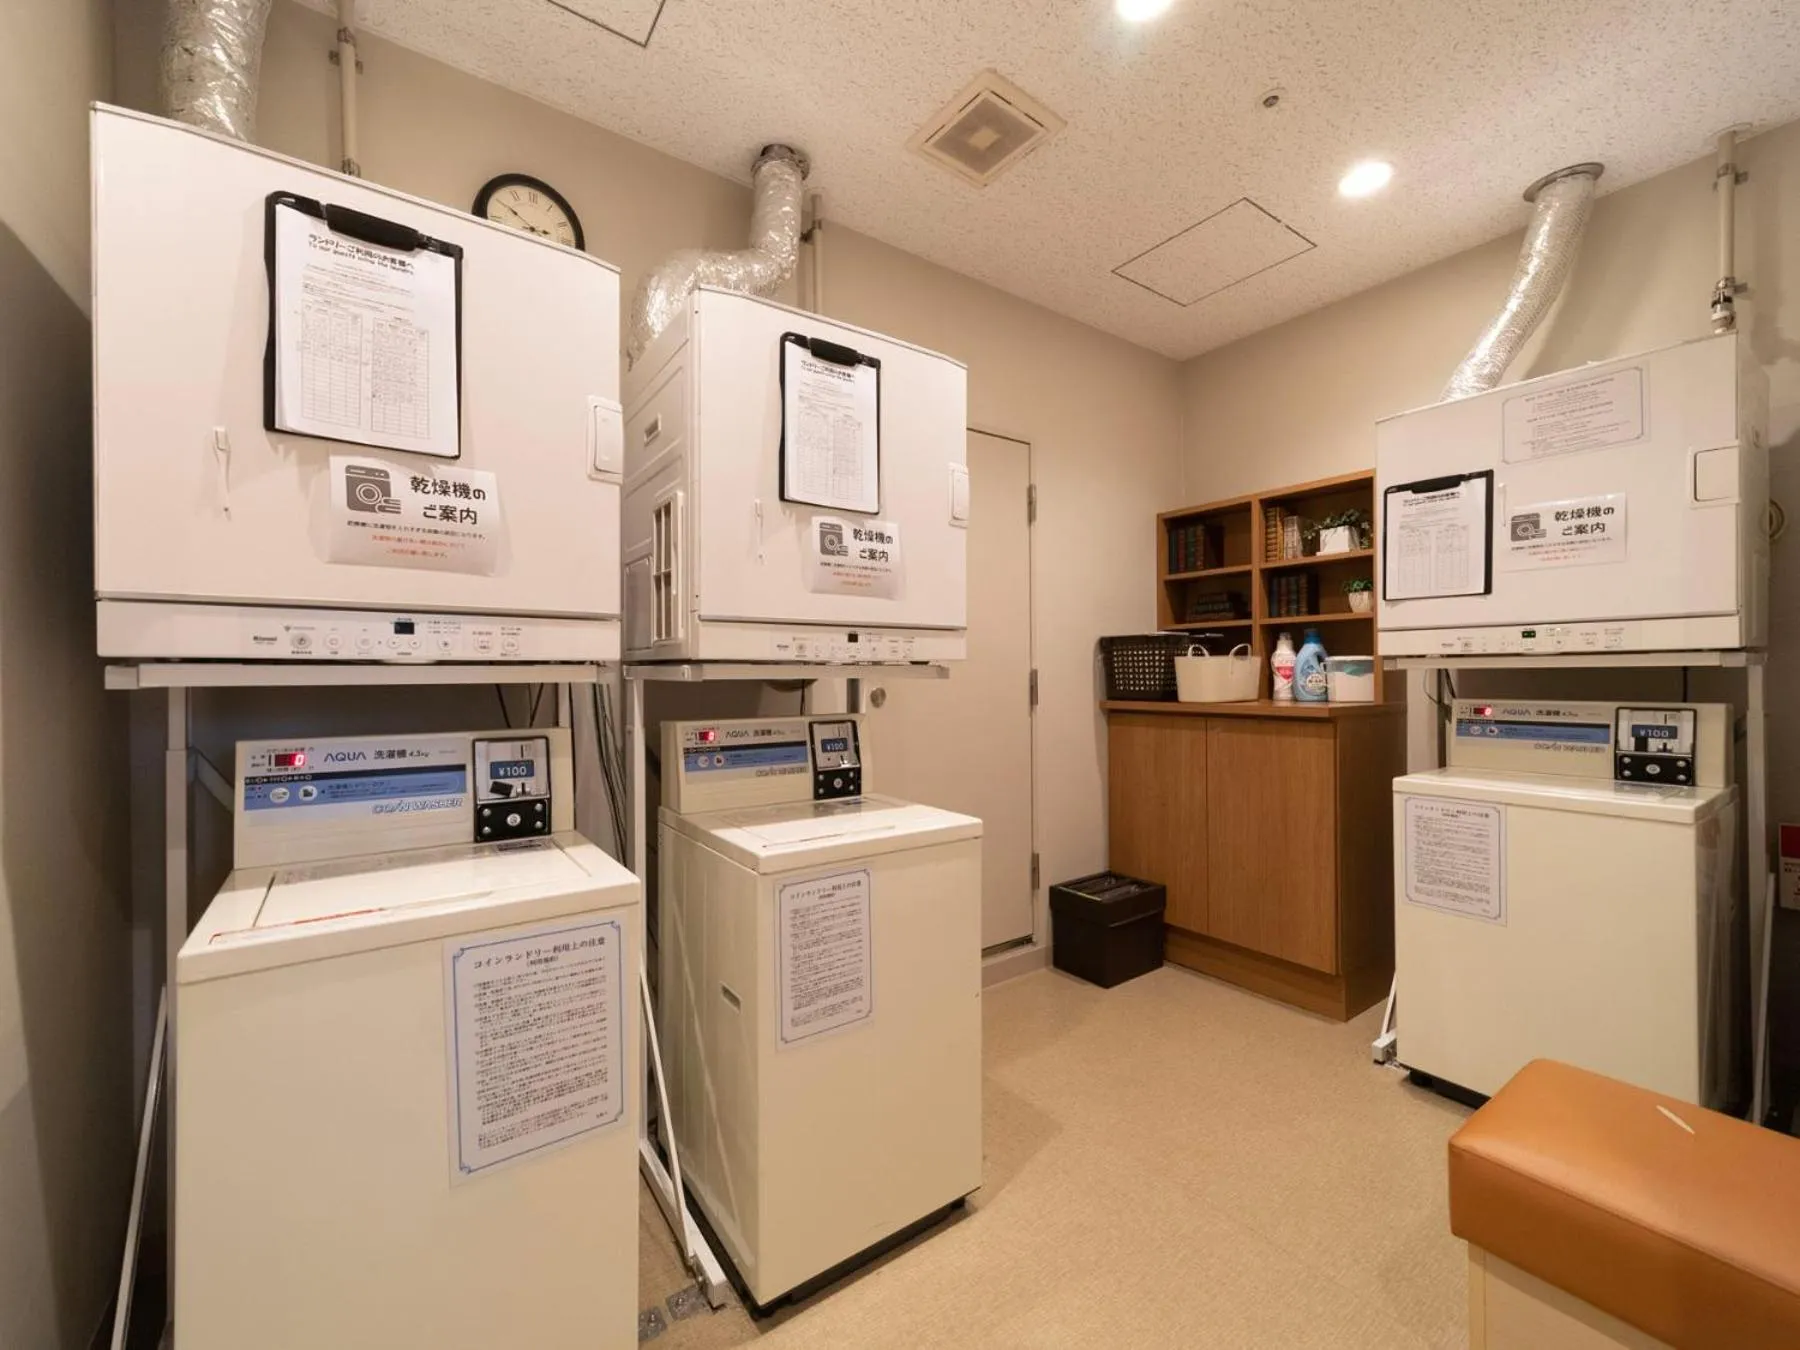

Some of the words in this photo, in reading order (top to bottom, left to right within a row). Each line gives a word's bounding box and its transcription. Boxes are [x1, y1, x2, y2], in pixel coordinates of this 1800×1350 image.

[410, 475, 486, 501] 乾燥機の
[423, 504, 478, 525] ご案内
[1554, 505, 1615, 521] 乾燥機の
[853, 527, 894, 545] 乾燥機の
[1562, 522, 1606, 536] ご案内
[859, 548, 889, 562] ご案内
[1502, 708, 1532, 717] AQUA
[1640, 728, 1669, 738] ¥100
[323, 751, 368, 763] AQUA
[374, 748, 407, 760] 洗濯機
[498, 765, 527, 777] ¥100
[473, 936, 606, 970] コインランドリー利用上の注意
